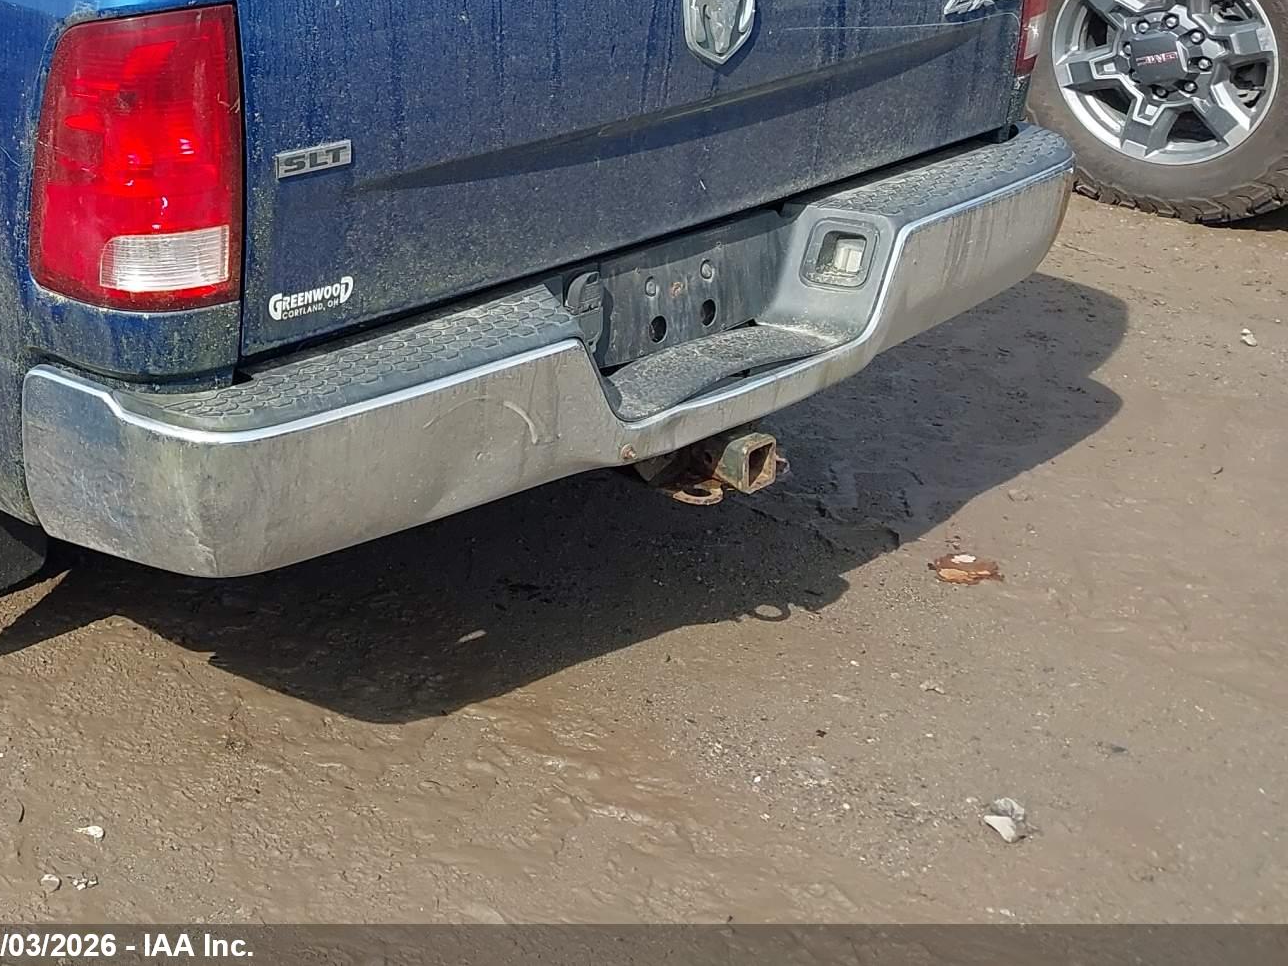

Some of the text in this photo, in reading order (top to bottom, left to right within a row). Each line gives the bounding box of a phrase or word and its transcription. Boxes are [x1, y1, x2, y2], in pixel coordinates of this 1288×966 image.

[1135, 51, 1178, 67] GMC
[283, 145, 348, 174] SLT
[268, 275, 354, 321] GREENWOOD
[282, 297, 339, 321] CORTLAND, OH
